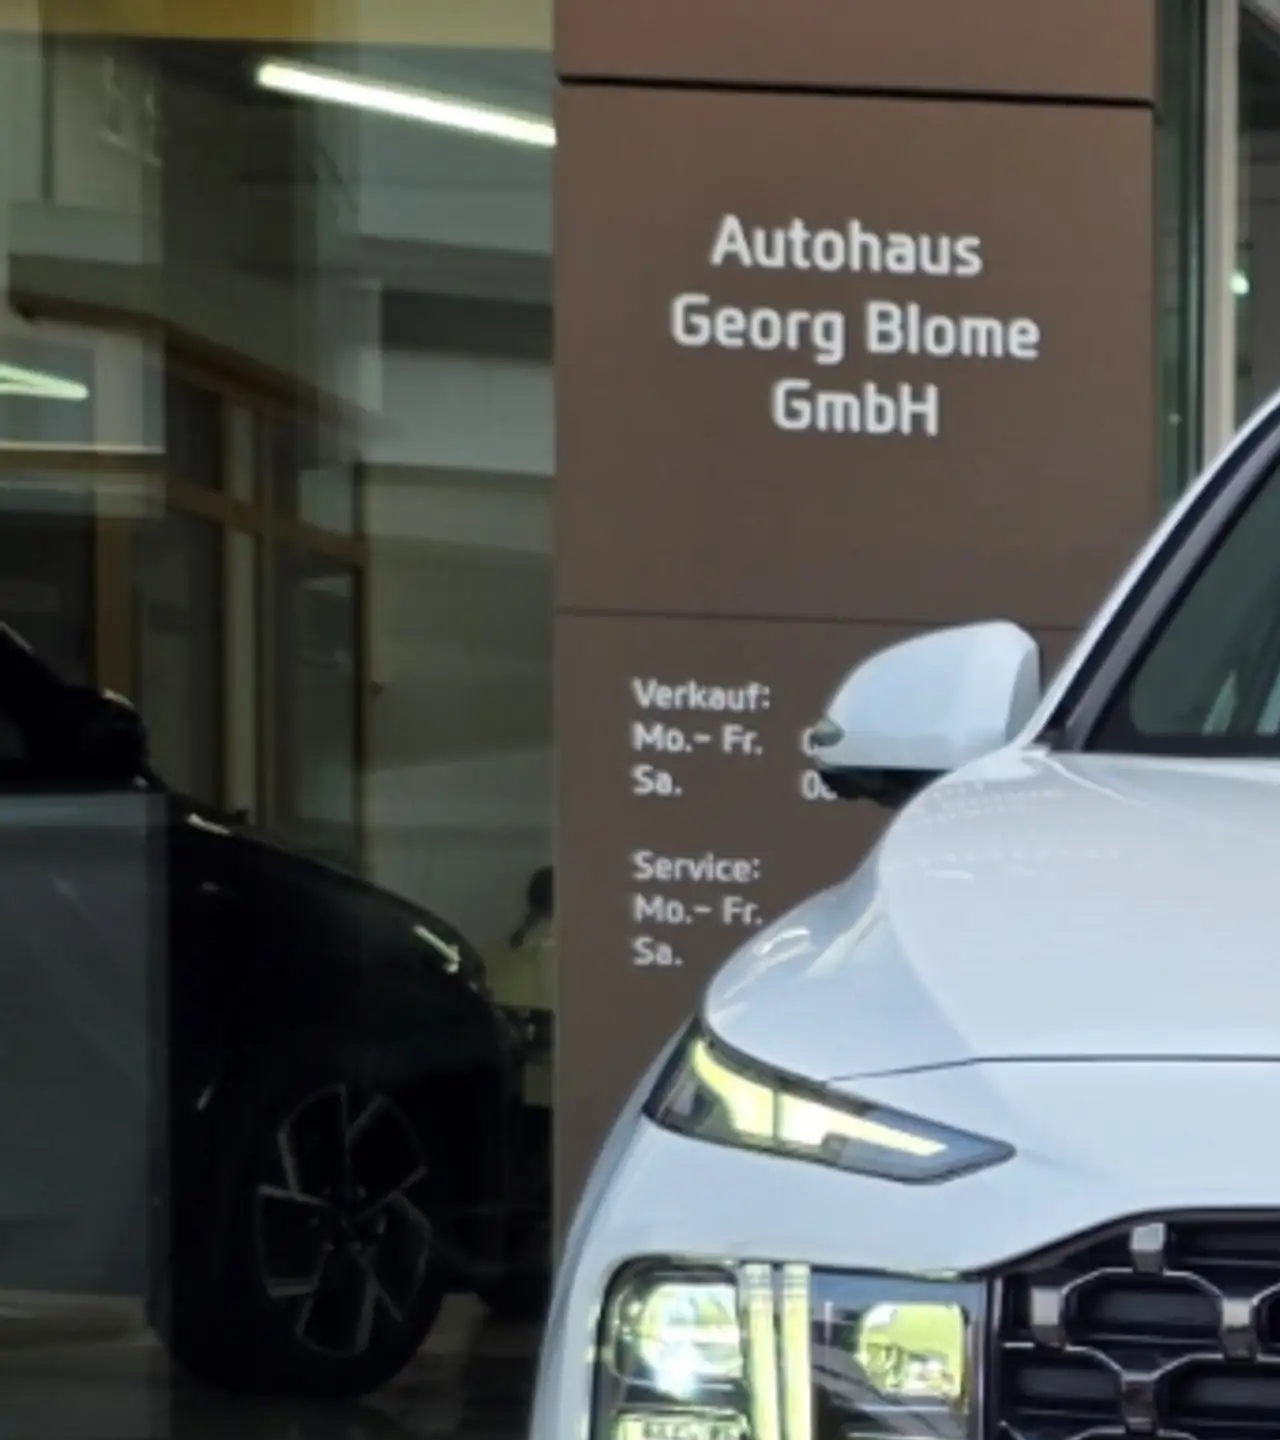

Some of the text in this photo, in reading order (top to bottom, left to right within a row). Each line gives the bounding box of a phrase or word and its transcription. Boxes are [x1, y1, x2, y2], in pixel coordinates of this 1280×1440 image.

[710, 213, 983, 277] Autohaus
[670, 293, 1041, 365] Georg Blome
[772, 378, 939, 436] GmbH
[631, 677, 771, 711] Verkauf:
[721, 724, 764, 755] Fr.
[631, 764, 683, 796] Sa.
[632, 849, 761, 883] Service:
[721, 896, 764, 925] Fr.
[631, 936, 684, 966] Sa.
